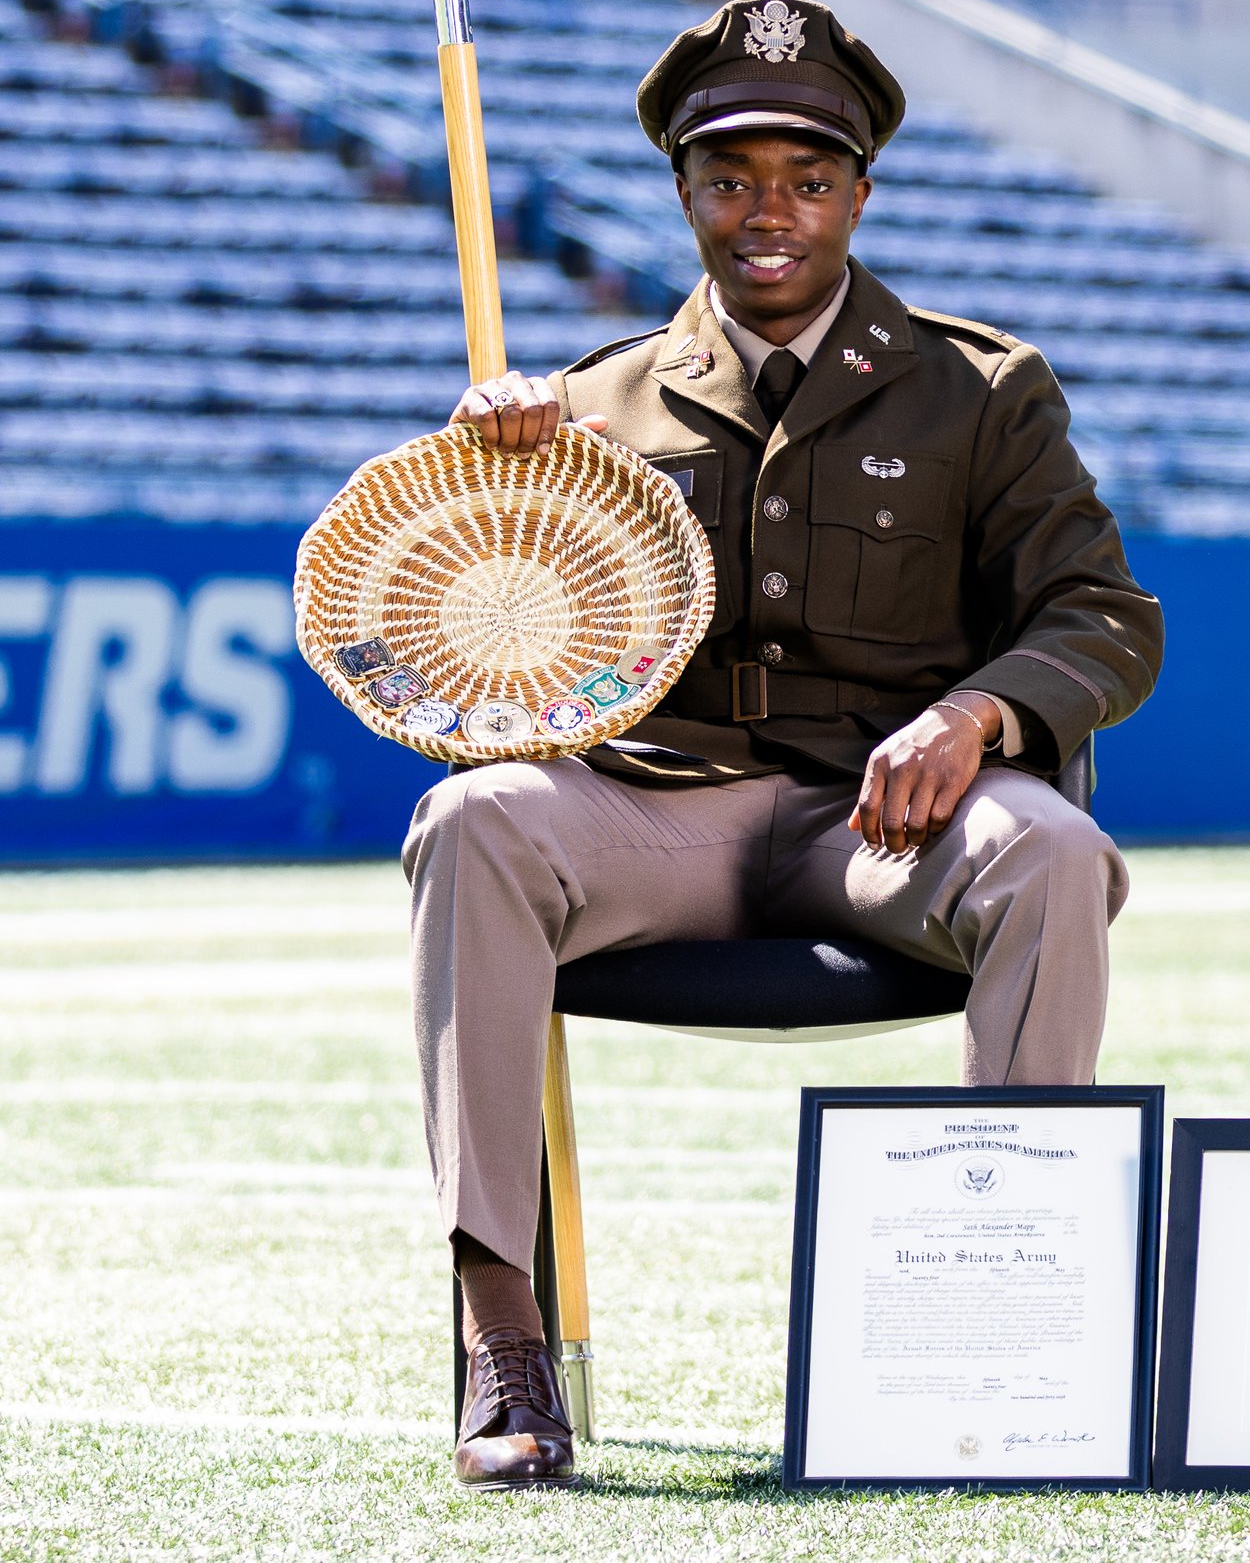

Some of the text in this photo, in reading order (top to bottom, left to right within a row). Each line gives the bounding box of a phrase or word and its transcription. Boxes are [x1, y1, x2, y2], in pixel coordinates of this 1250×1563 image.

[945, 1124, 1020, 1135] PRESIDENT
[886, 1140, 1079, 1162] THE UNITED STATES OF AMERICA
[962, 1223, 1036, 1232] Seth Alexander Mapp
[895, 1249, 1057, 1265] United States Army
